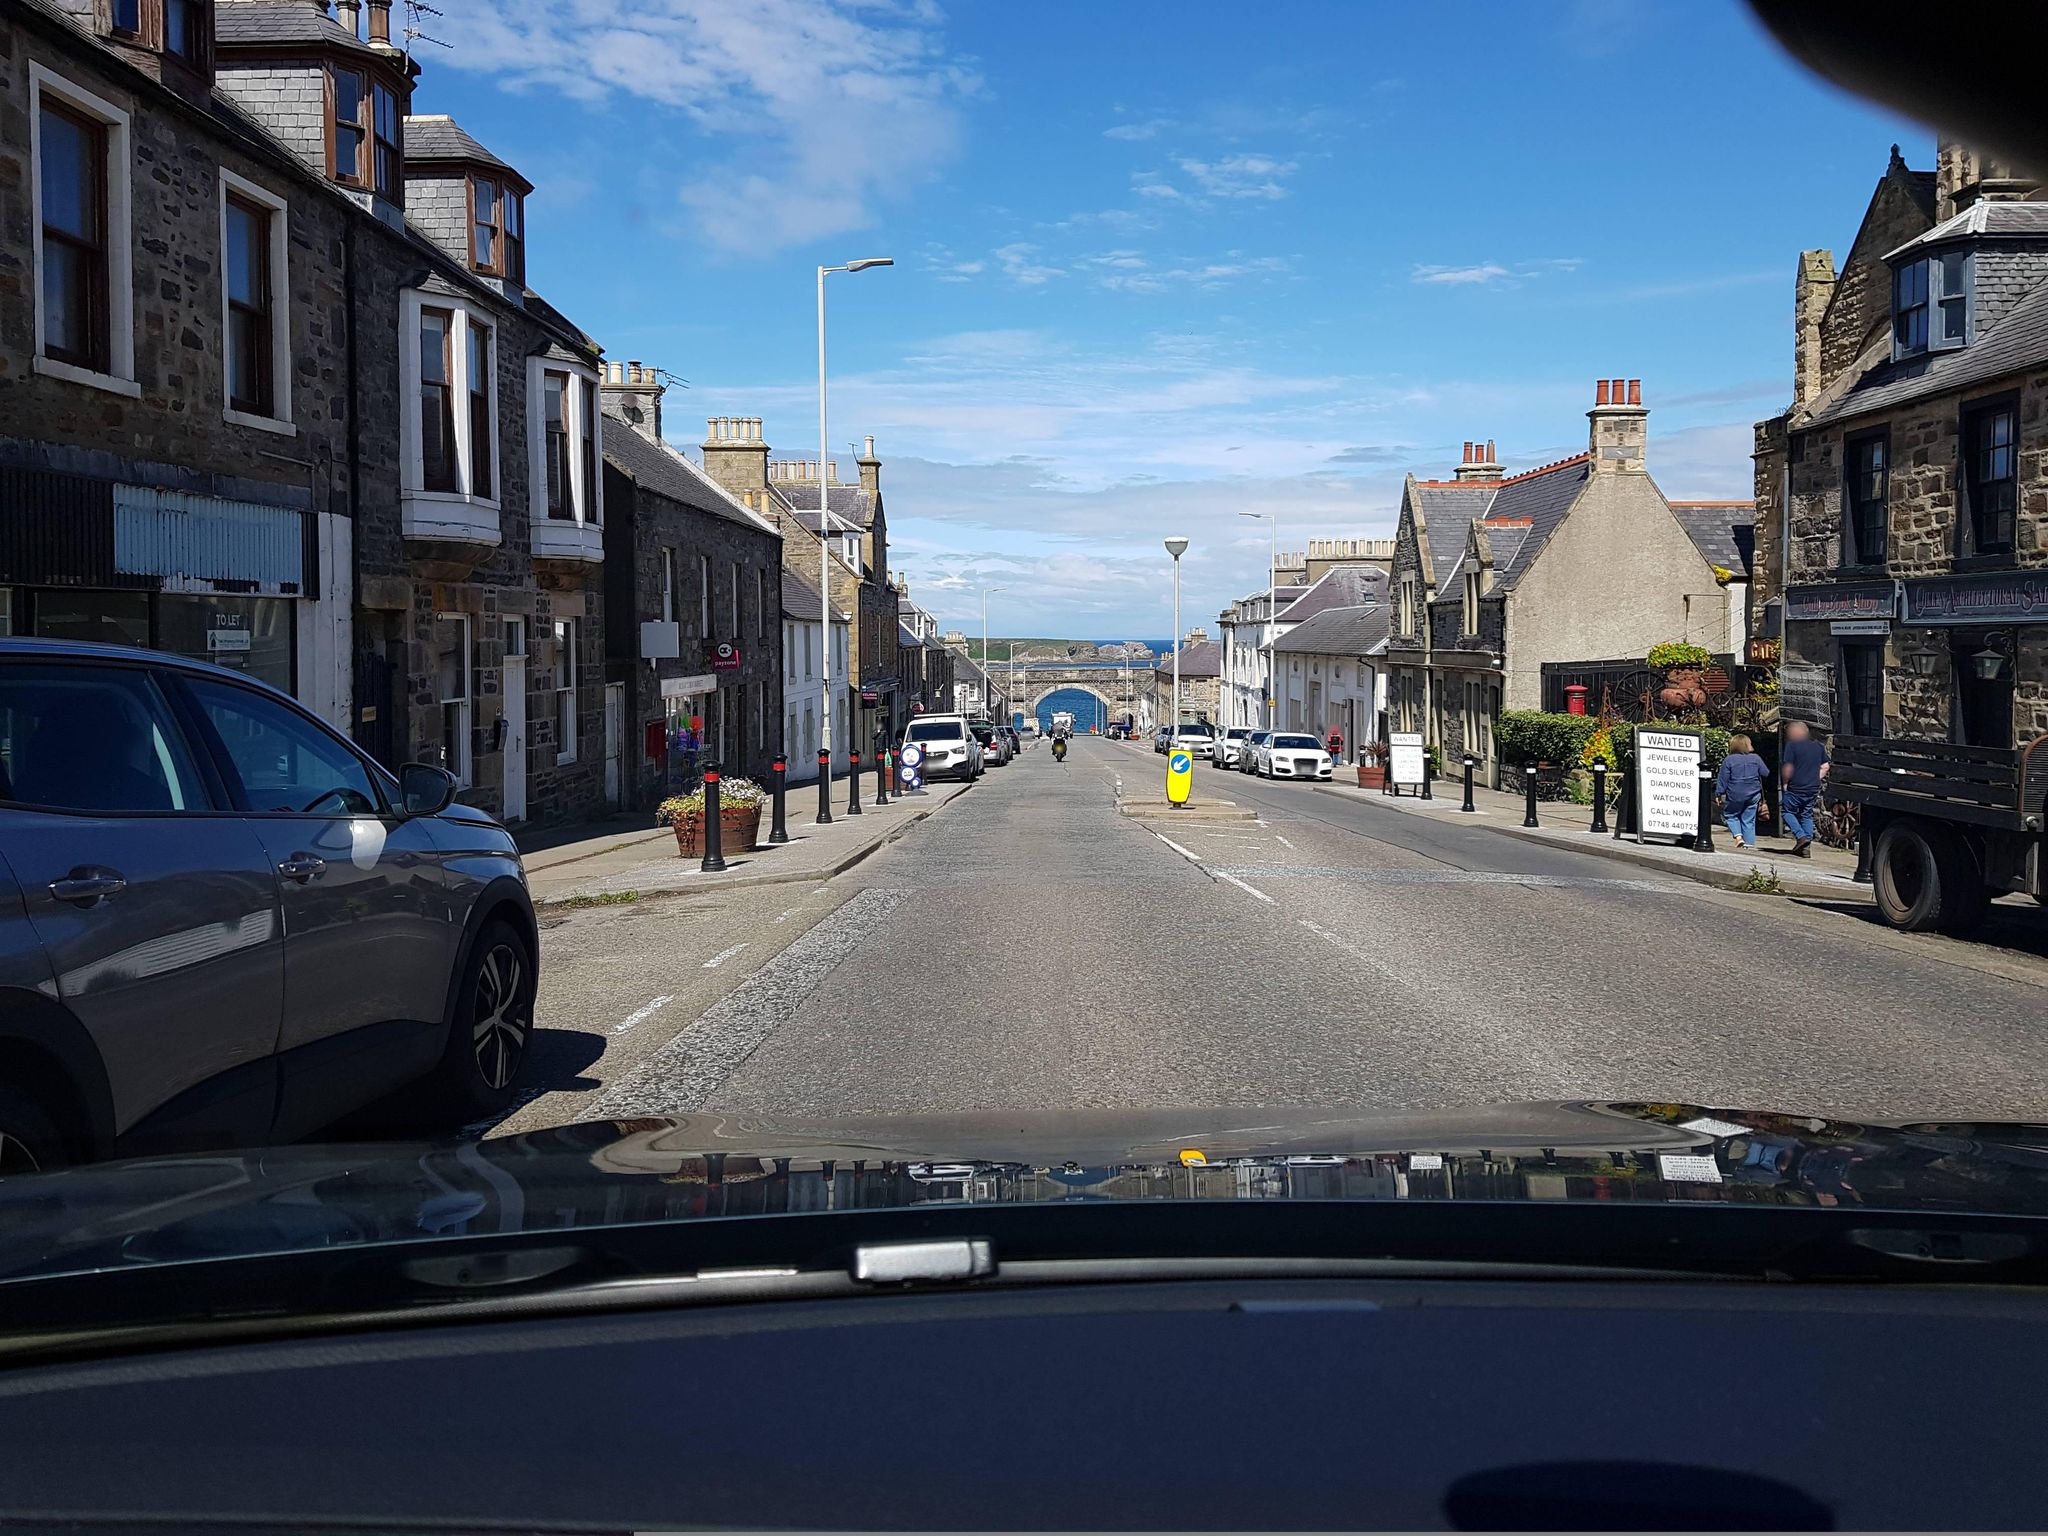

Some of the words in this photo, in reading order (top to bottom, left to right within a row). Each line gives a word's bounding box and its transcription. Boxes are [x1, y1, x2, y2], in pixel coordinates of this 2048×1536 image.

[216, 614, 226, 625] TO
[228, 614, 240, 625] LET
[714, 660, 736, 668] payzone
[1647, 736, 1692, 748] WANTED
[1647, 754, 1693, 763] JEWELLERY
[1646, 766, 1667, 775] GOLD
[1669, 768, 1695, 777] SILVER
[1650, 779, 1692, 789] DIAMONDS
[1652, 794, 1690, 803] WATCHES
[1650, 807, 1670, 816] CALL
[1672, 809, 1692, 817] NOW
[1648, 820, 1669, 828] 07748
[1671, 822, 1698, 830] 440725
